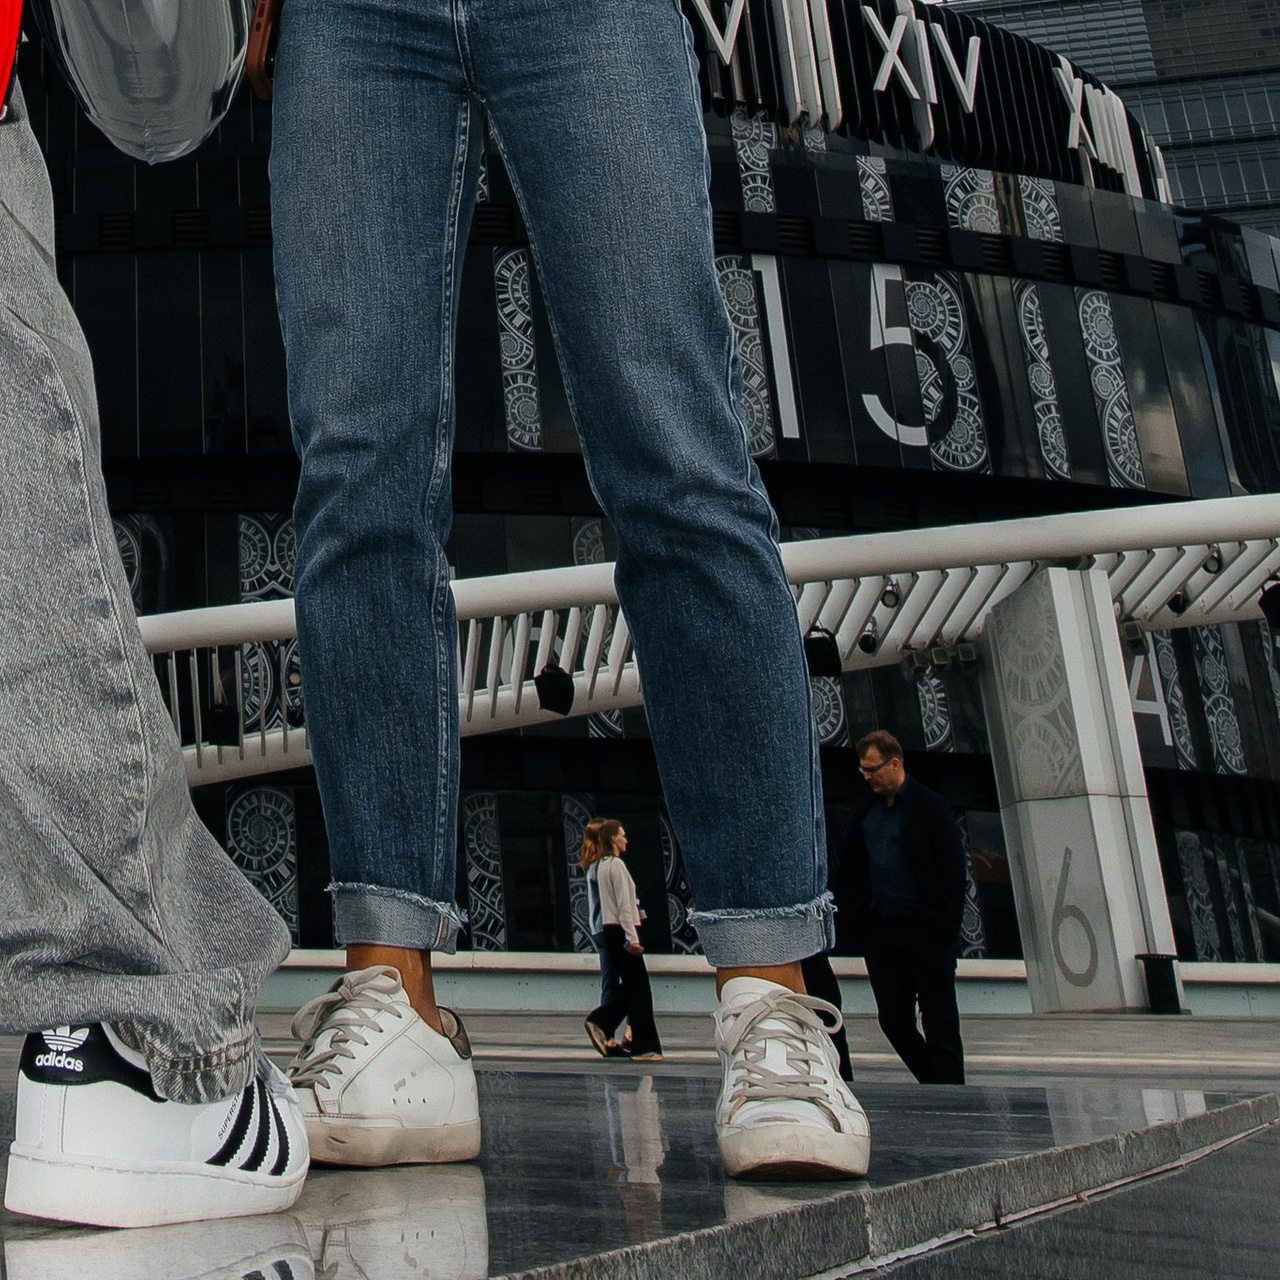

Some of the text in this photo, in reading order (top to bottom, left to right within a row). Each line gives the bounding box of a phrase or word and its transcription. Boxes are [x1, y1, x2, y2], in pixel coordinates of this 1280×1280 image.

[862, 5, 981, 114] XIV
[751, 253, 958, 448] 15
[1051, 845, 1099, 988] 6
[35, 1051, 84, 1073] adidas
[217, 1090, 241, 1140] SUPERSTA
